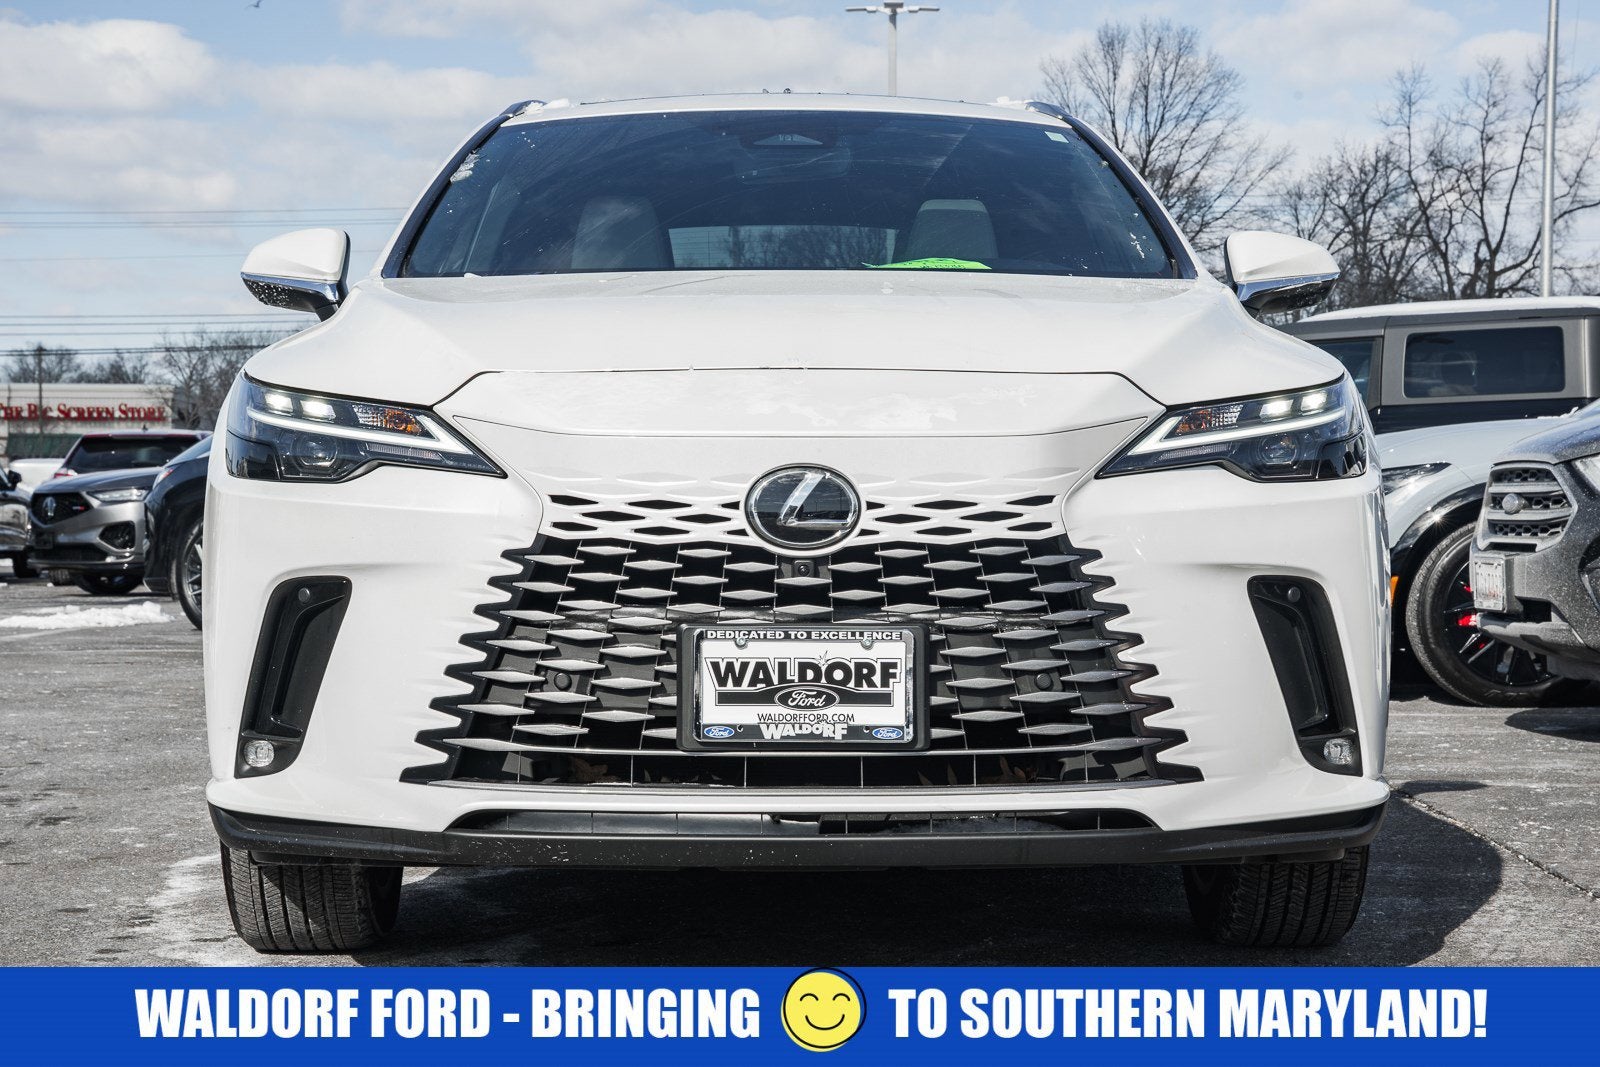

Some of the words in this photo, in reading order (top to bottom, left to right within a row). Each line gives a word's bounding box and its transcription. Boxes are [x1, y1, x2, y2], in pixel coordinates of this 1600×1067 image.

[27, 403, 53, 421] BG
[57, 403, 115, 421] SCREEN
[118, 403, 166, 421] STORE
[706, 630, 786, 640] DEDICATED
[788, 630, 807, 640] TO
[811, 631, 901, 641] EXCELLENCE
[707, 659, 900, 688] WALDORF
[787, 690, 826, 707] Ford
[757, 713, 855, 723] WALDORFFORD.COM
[708, 727, 729, 737] Ford
[758, 722, 849, 740] WALDORF
[876, 728, 898, 738] Ford
